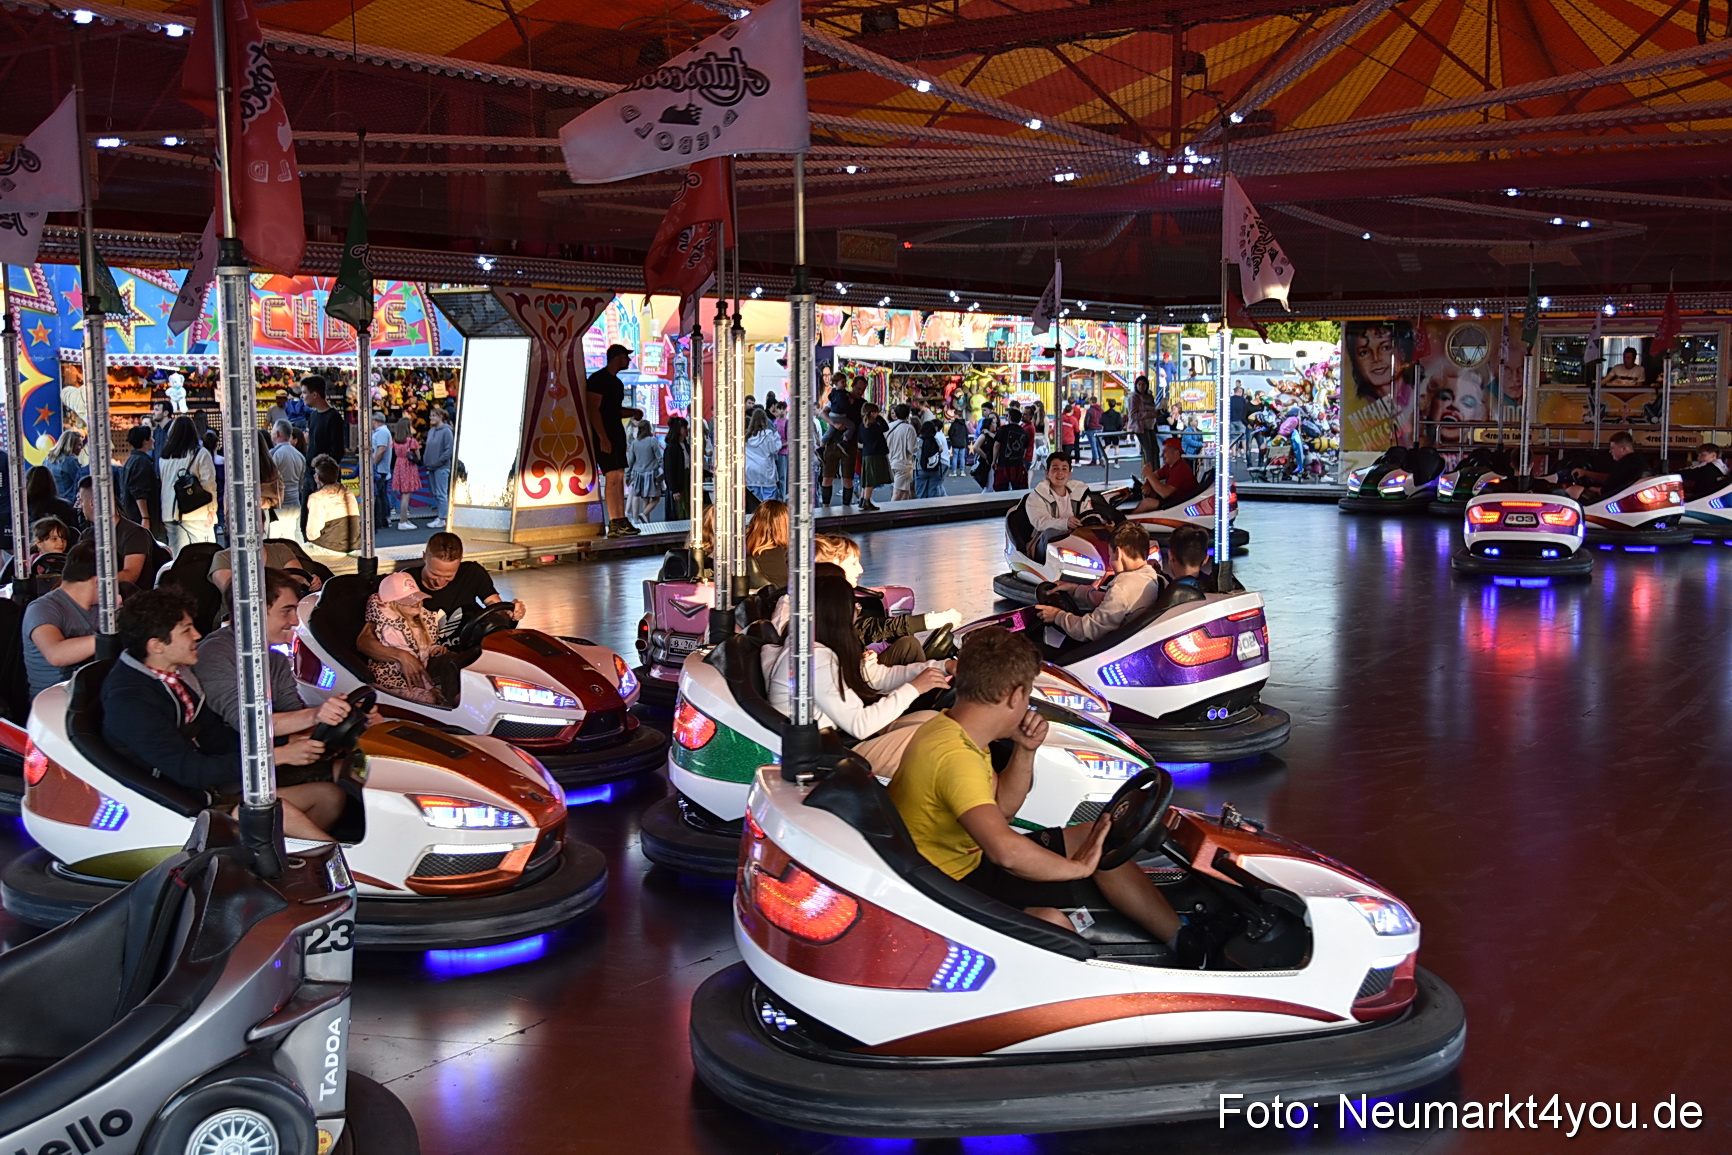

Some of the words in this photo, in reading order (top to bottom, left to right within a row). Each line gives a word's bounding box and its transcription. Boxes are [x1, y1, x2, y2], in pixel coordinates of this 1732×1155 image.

[306, 919, 355, 956] 23
[319, 1016, 342, 1102] TADOA
[14, 1108, 134, 1155] ello
